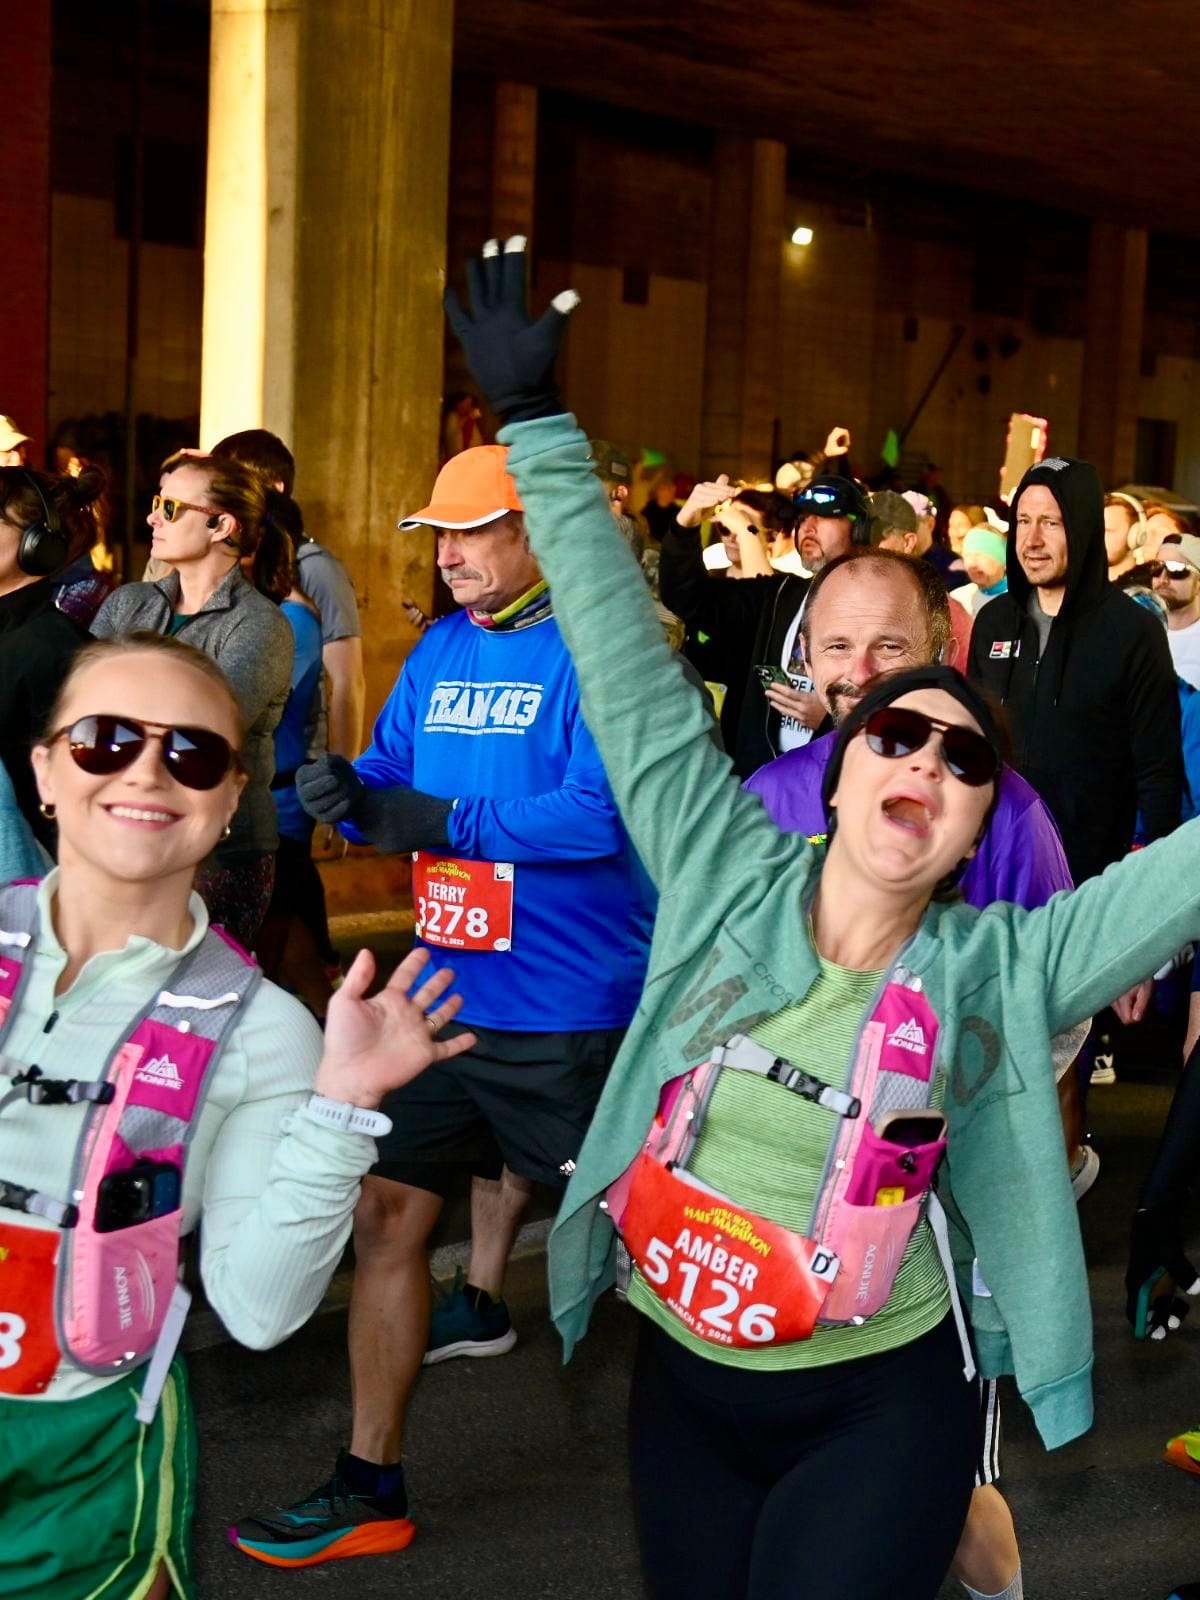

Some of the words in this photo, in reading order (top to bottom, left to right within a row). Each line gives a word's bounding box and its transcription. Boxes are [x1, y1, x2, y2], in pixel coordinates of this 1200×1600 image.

[424, 687, 495, 728] TEAM
[489, 688, 543, 727] 413
[427, 880, 467, 904] TERRY
[418, 896, 489, 939] 3278
[684, 1205, 710, 1224] HALF
[709, 1214, 772, 1258] MARATHON
[674, 1228, 760, 1292] AMBER
[643, 1236, 777, 1343] 5126
[666, 1296, 696, 1326] MARCH
[706, 1328, 734, 1345] 2025
